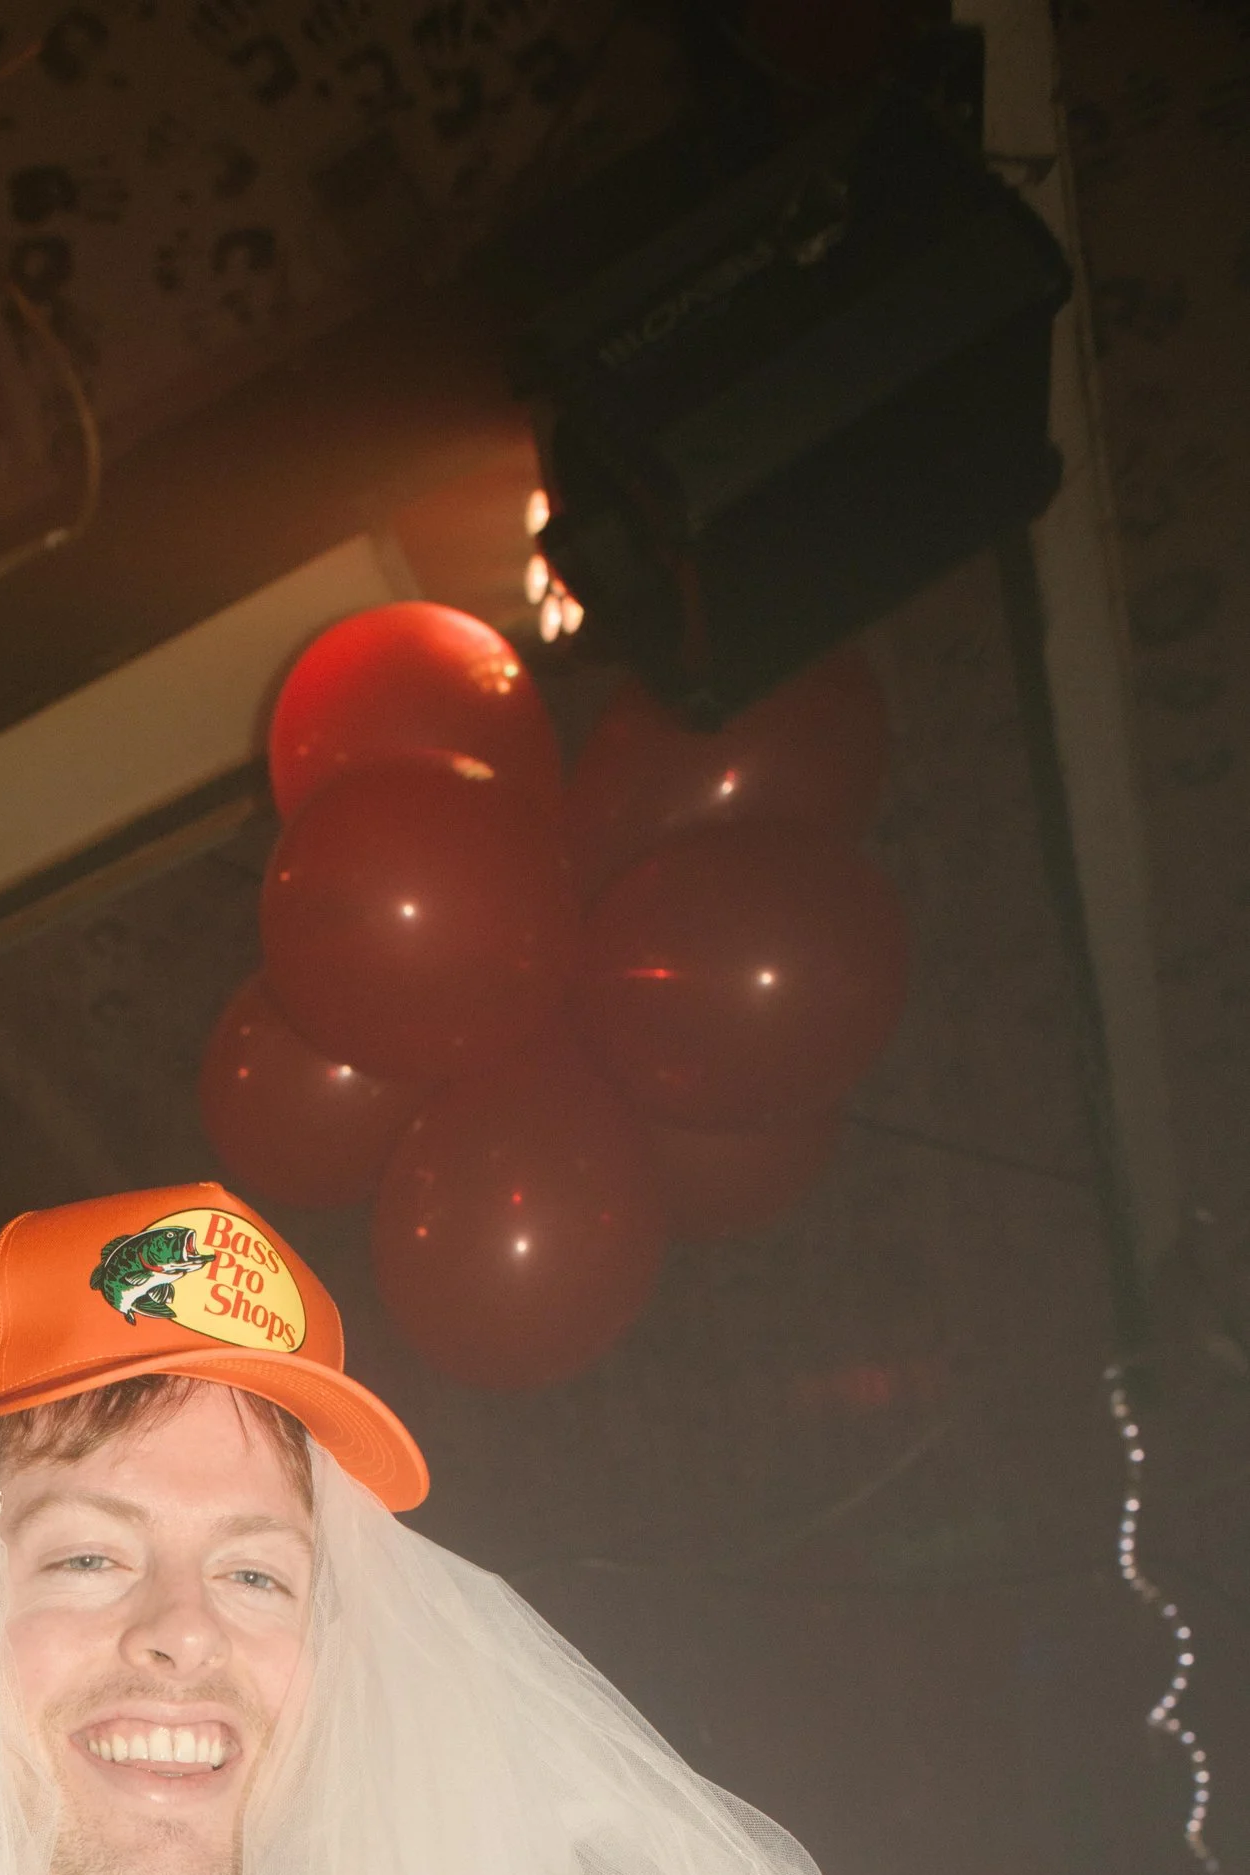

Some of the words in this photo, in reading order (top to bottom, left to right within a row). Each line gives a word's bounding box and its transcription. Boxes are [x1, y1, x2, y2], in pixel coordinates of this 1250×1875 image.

[202, 1213, 279, 1274] Bass
[206, 1249, 264, 1294] Pro
[204, 1283, 296, 1349] Shops
